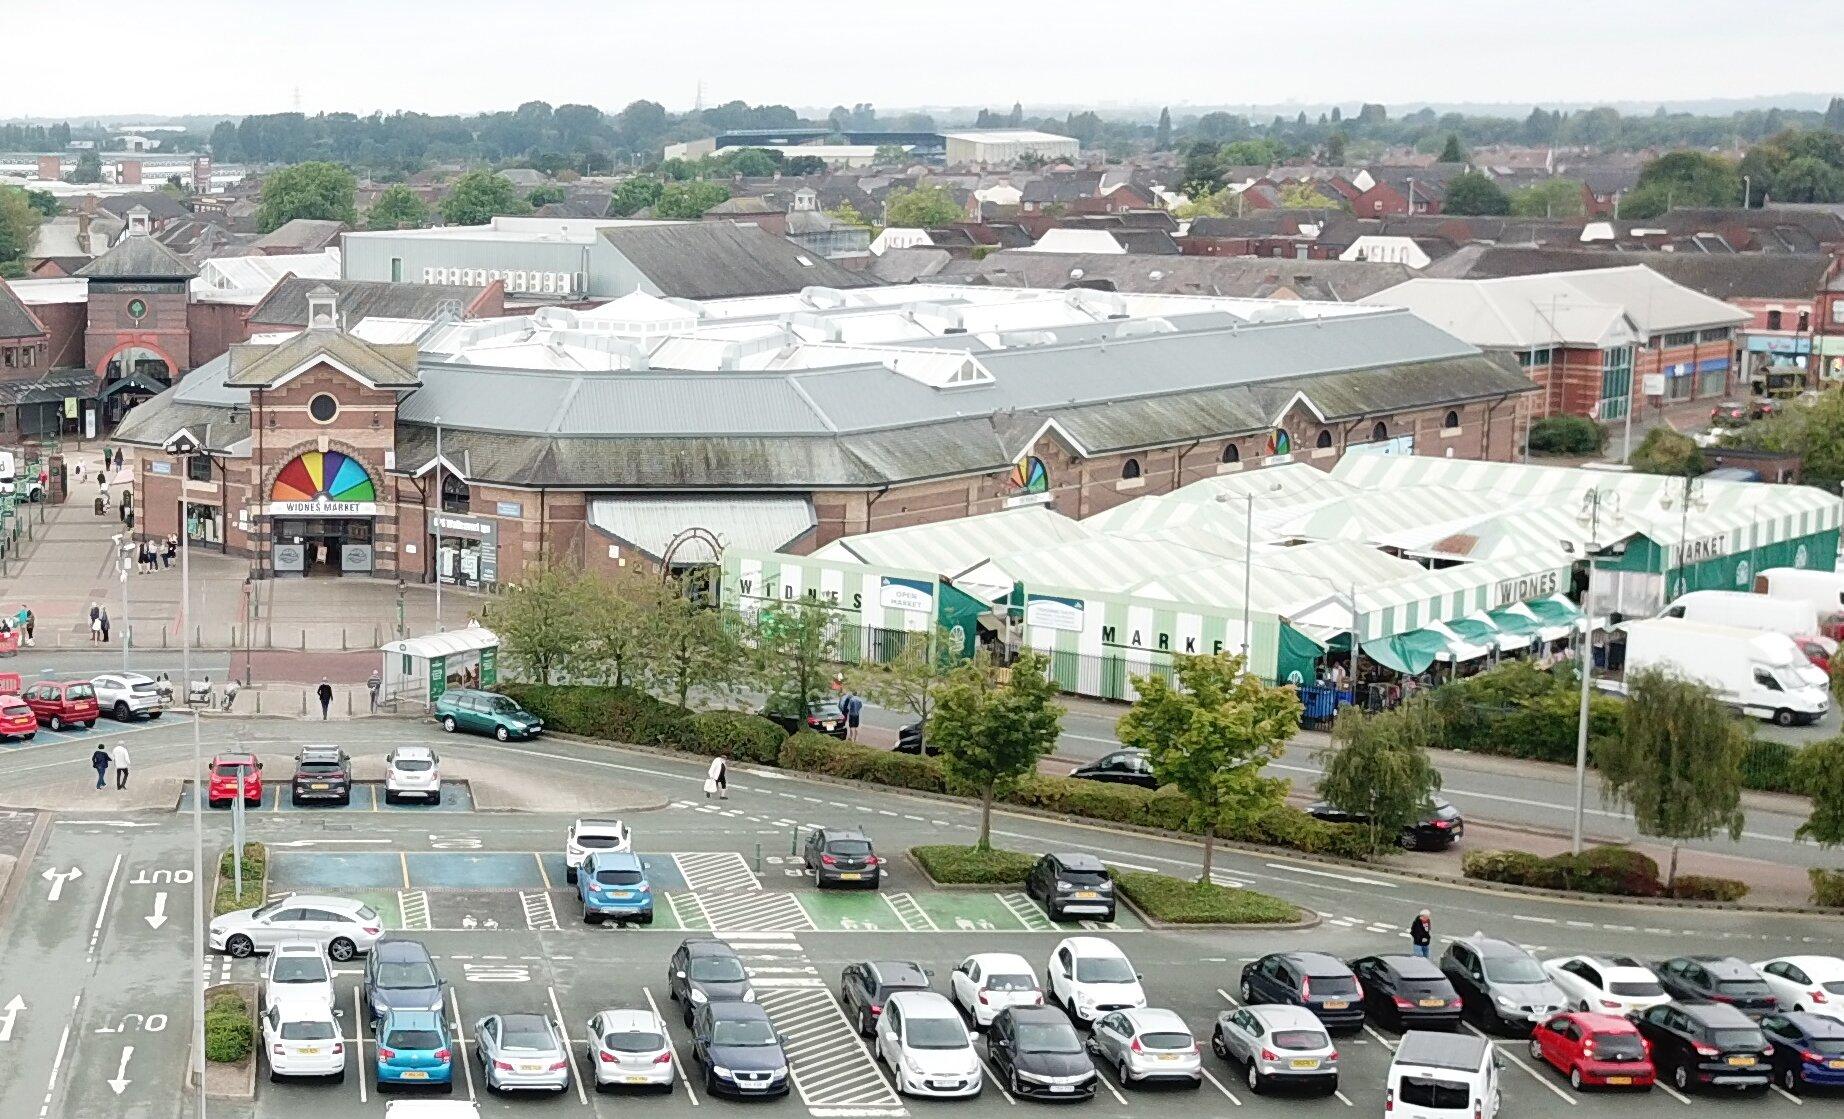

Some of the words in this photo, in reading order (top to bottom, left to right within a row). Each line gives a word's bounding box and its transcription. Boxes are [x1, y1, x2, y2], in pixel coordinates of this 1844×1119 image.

[286, 502, 321, 512] WIDNES
[323, 502, 361, 512] MARKET
[739, 578, 863, 609] WIDNES
[1500, 571, 1557, 604] WIDNES
[129, 869, 194, 884] OUT
[94, 1013, 168, 1033] OUT
